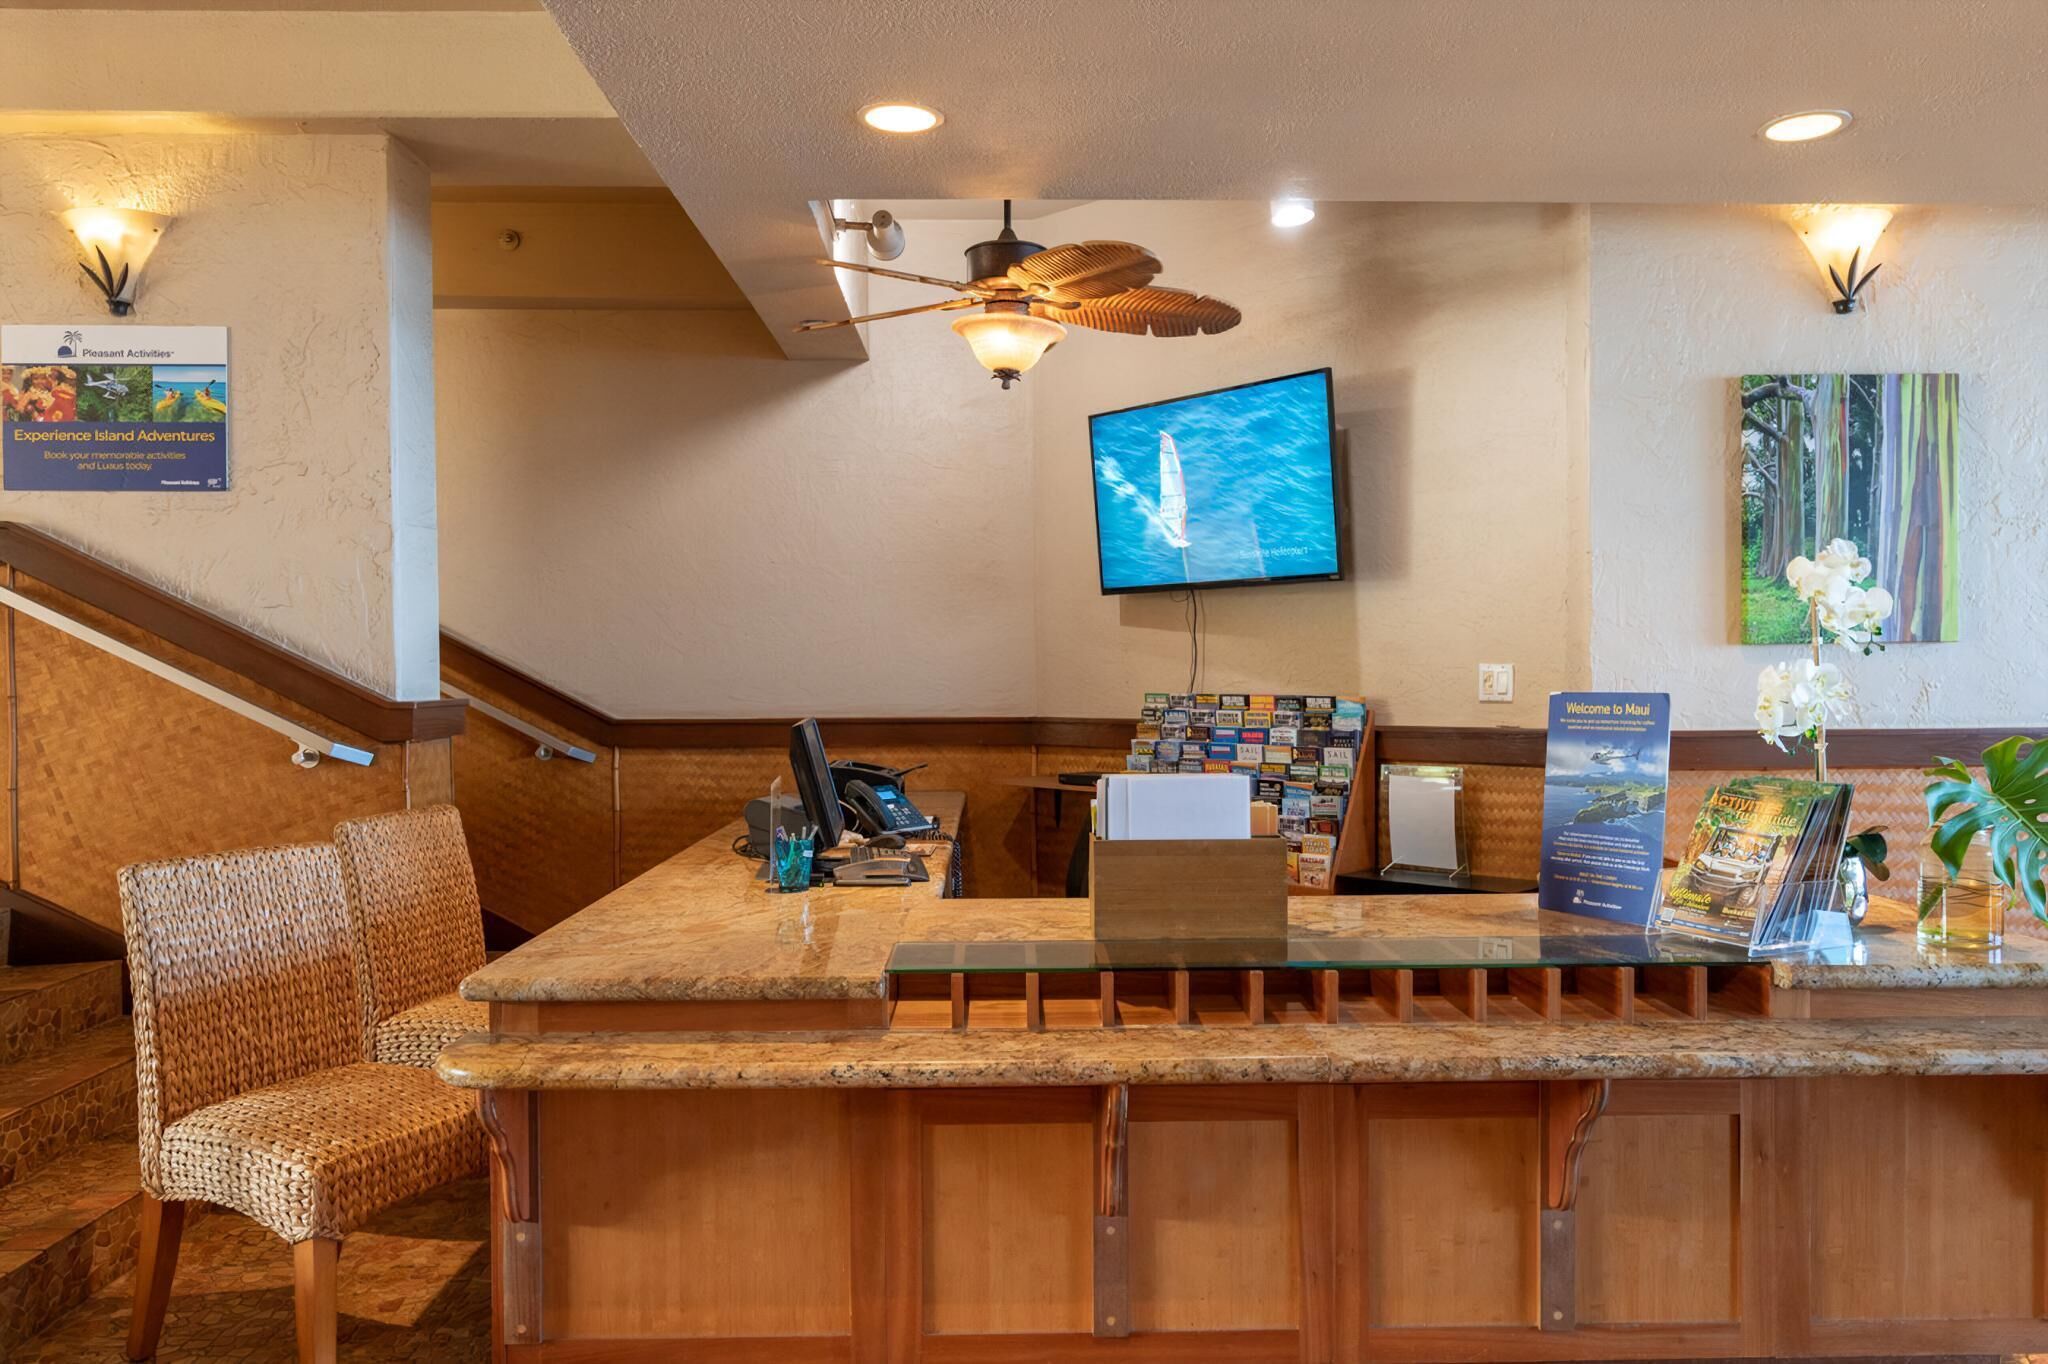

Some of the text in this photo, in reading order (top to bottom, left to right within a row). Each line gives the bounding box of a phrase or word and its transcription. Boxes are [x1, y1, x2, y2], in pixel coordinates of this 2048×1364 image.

[82, 349, 124, 358] Pleasant
[14, 429, 215, 443] Experience Island Adventures
[43, 451, 67, 460] Book
[77, 462, 96, 470] and
[1566, 702, 1651, 716] Welcome to Maui
[1327, 751, 1349, 759] SAIL
